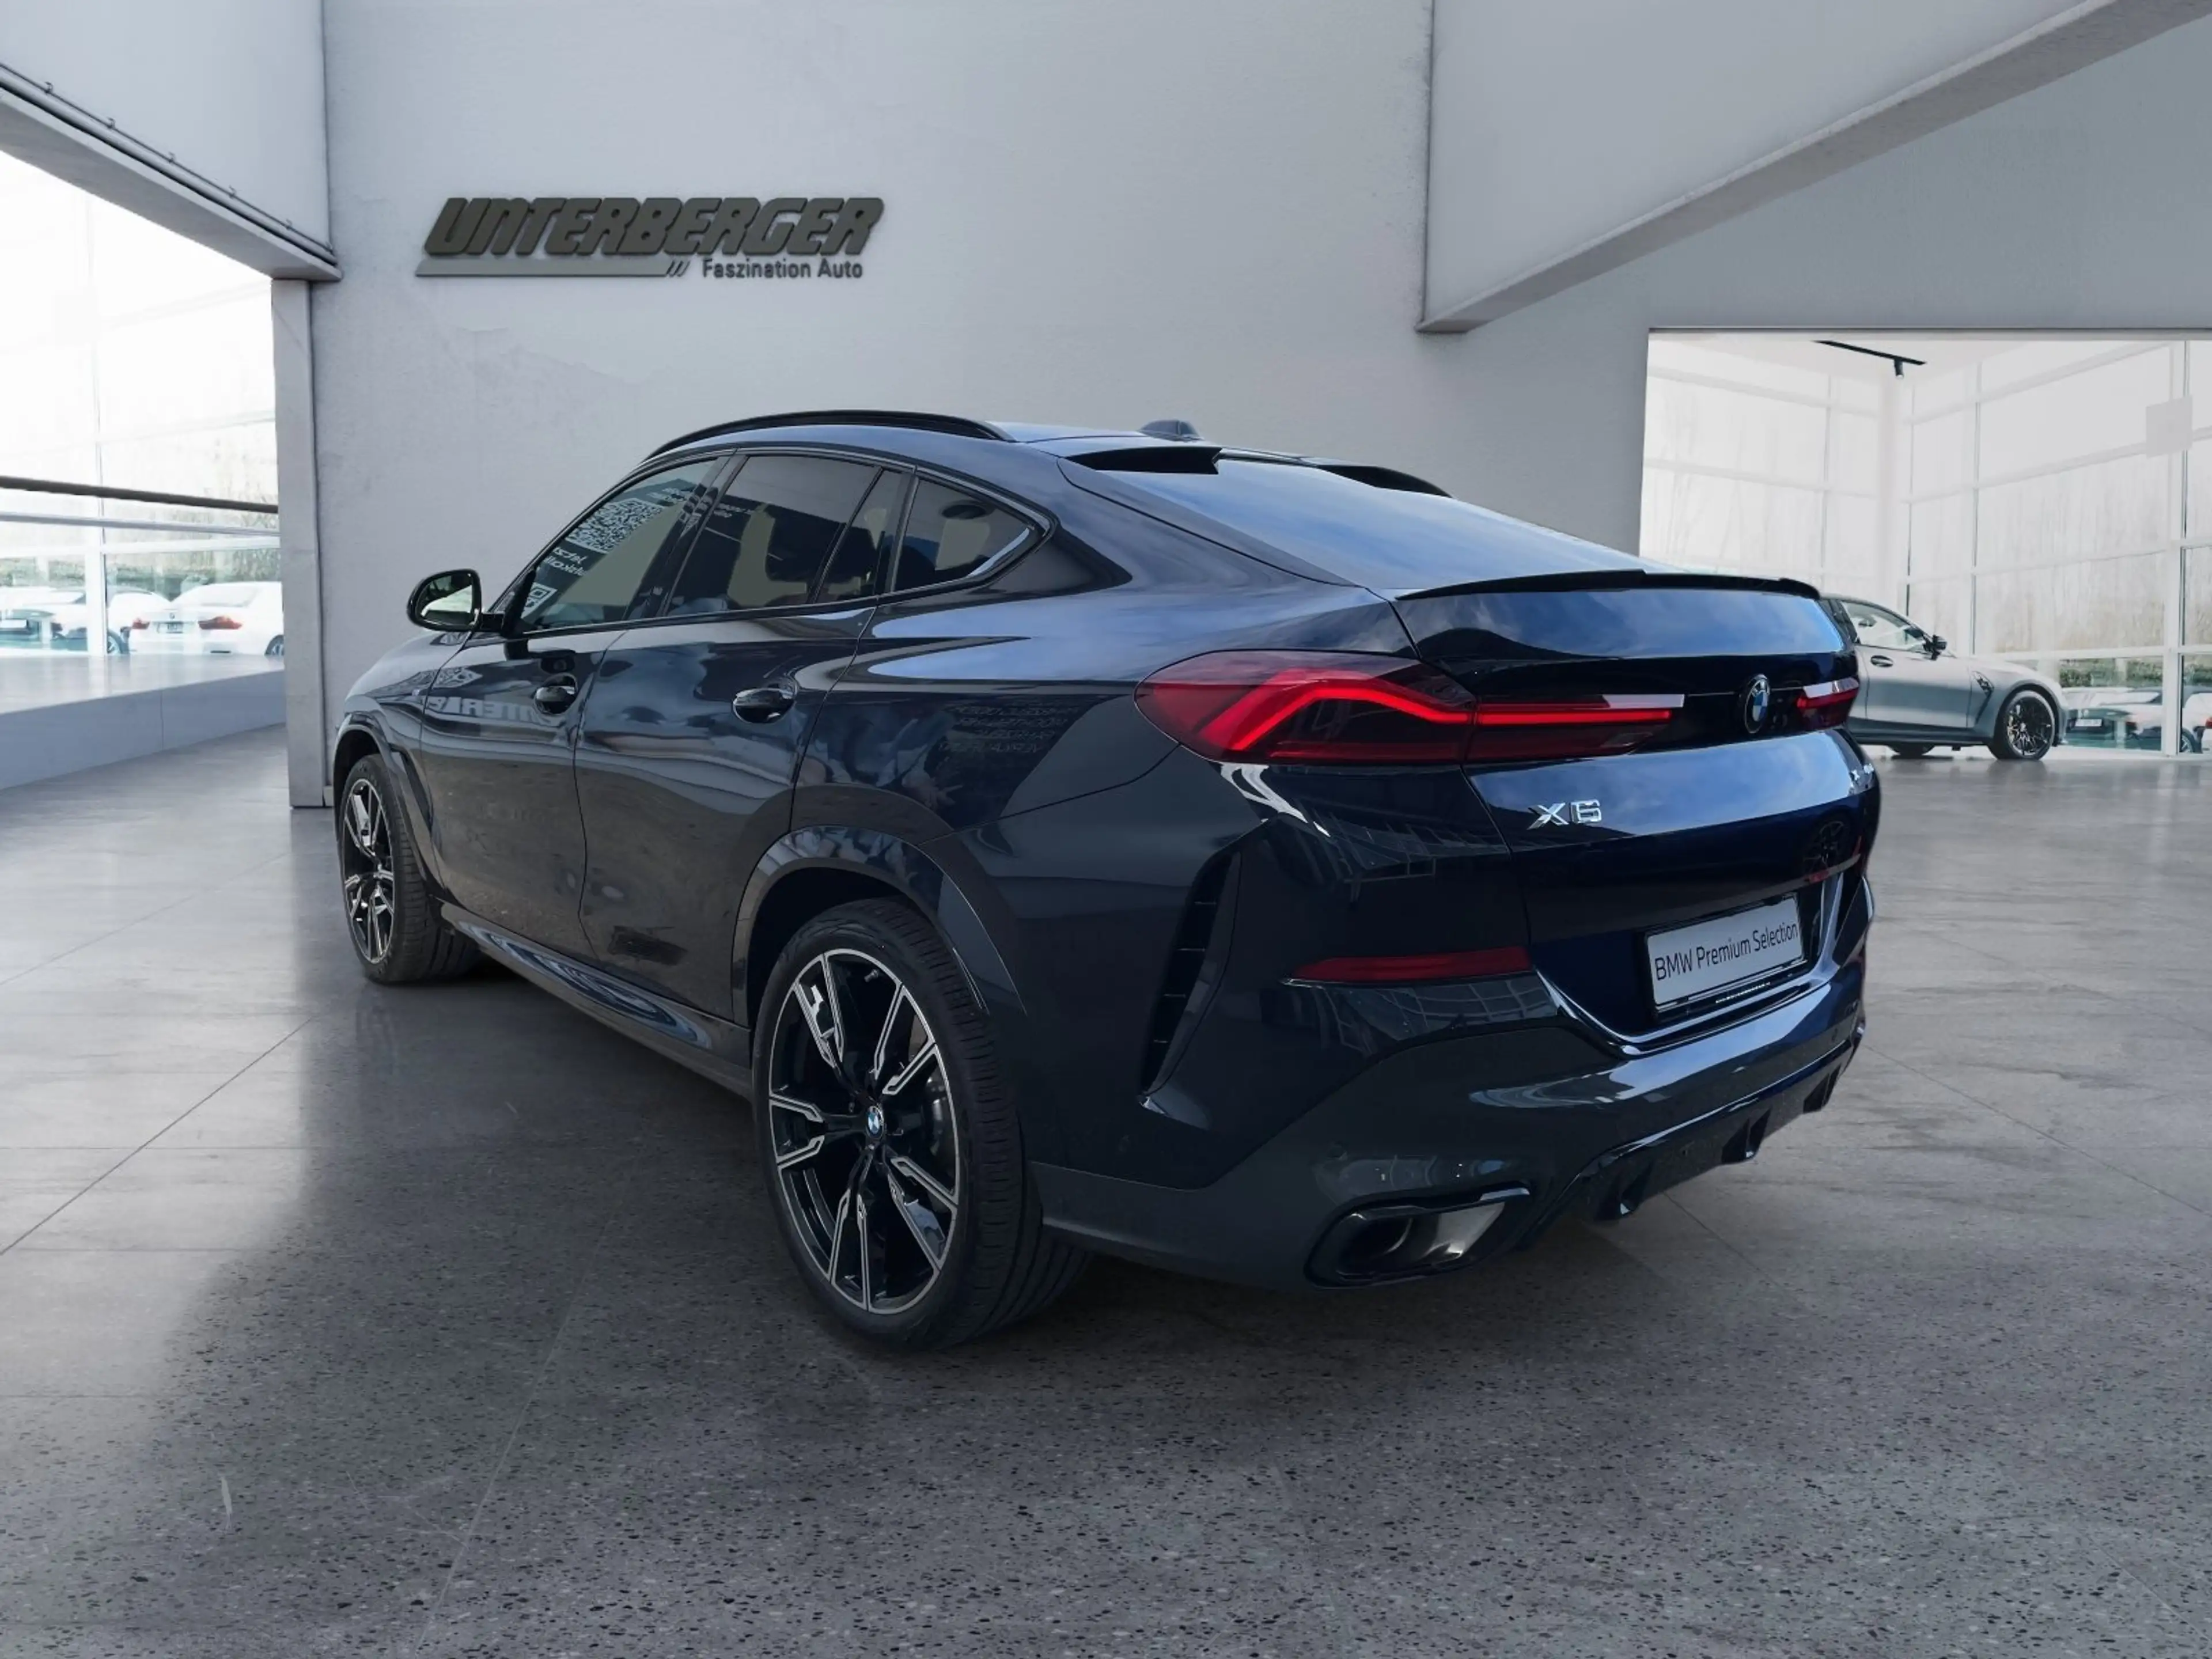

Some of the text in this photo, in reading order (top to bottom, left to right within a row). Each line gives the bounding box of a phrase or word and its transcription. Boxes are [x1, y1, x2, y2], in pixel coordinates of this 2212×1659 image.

[424, 197, 885, 257] UNTERBERGER
[702, 258, 863, 279] Faszination Auto
[1526, 798, 1602, 831] X6
[1654, 922, 1798, 981] BMW Premium Selection
